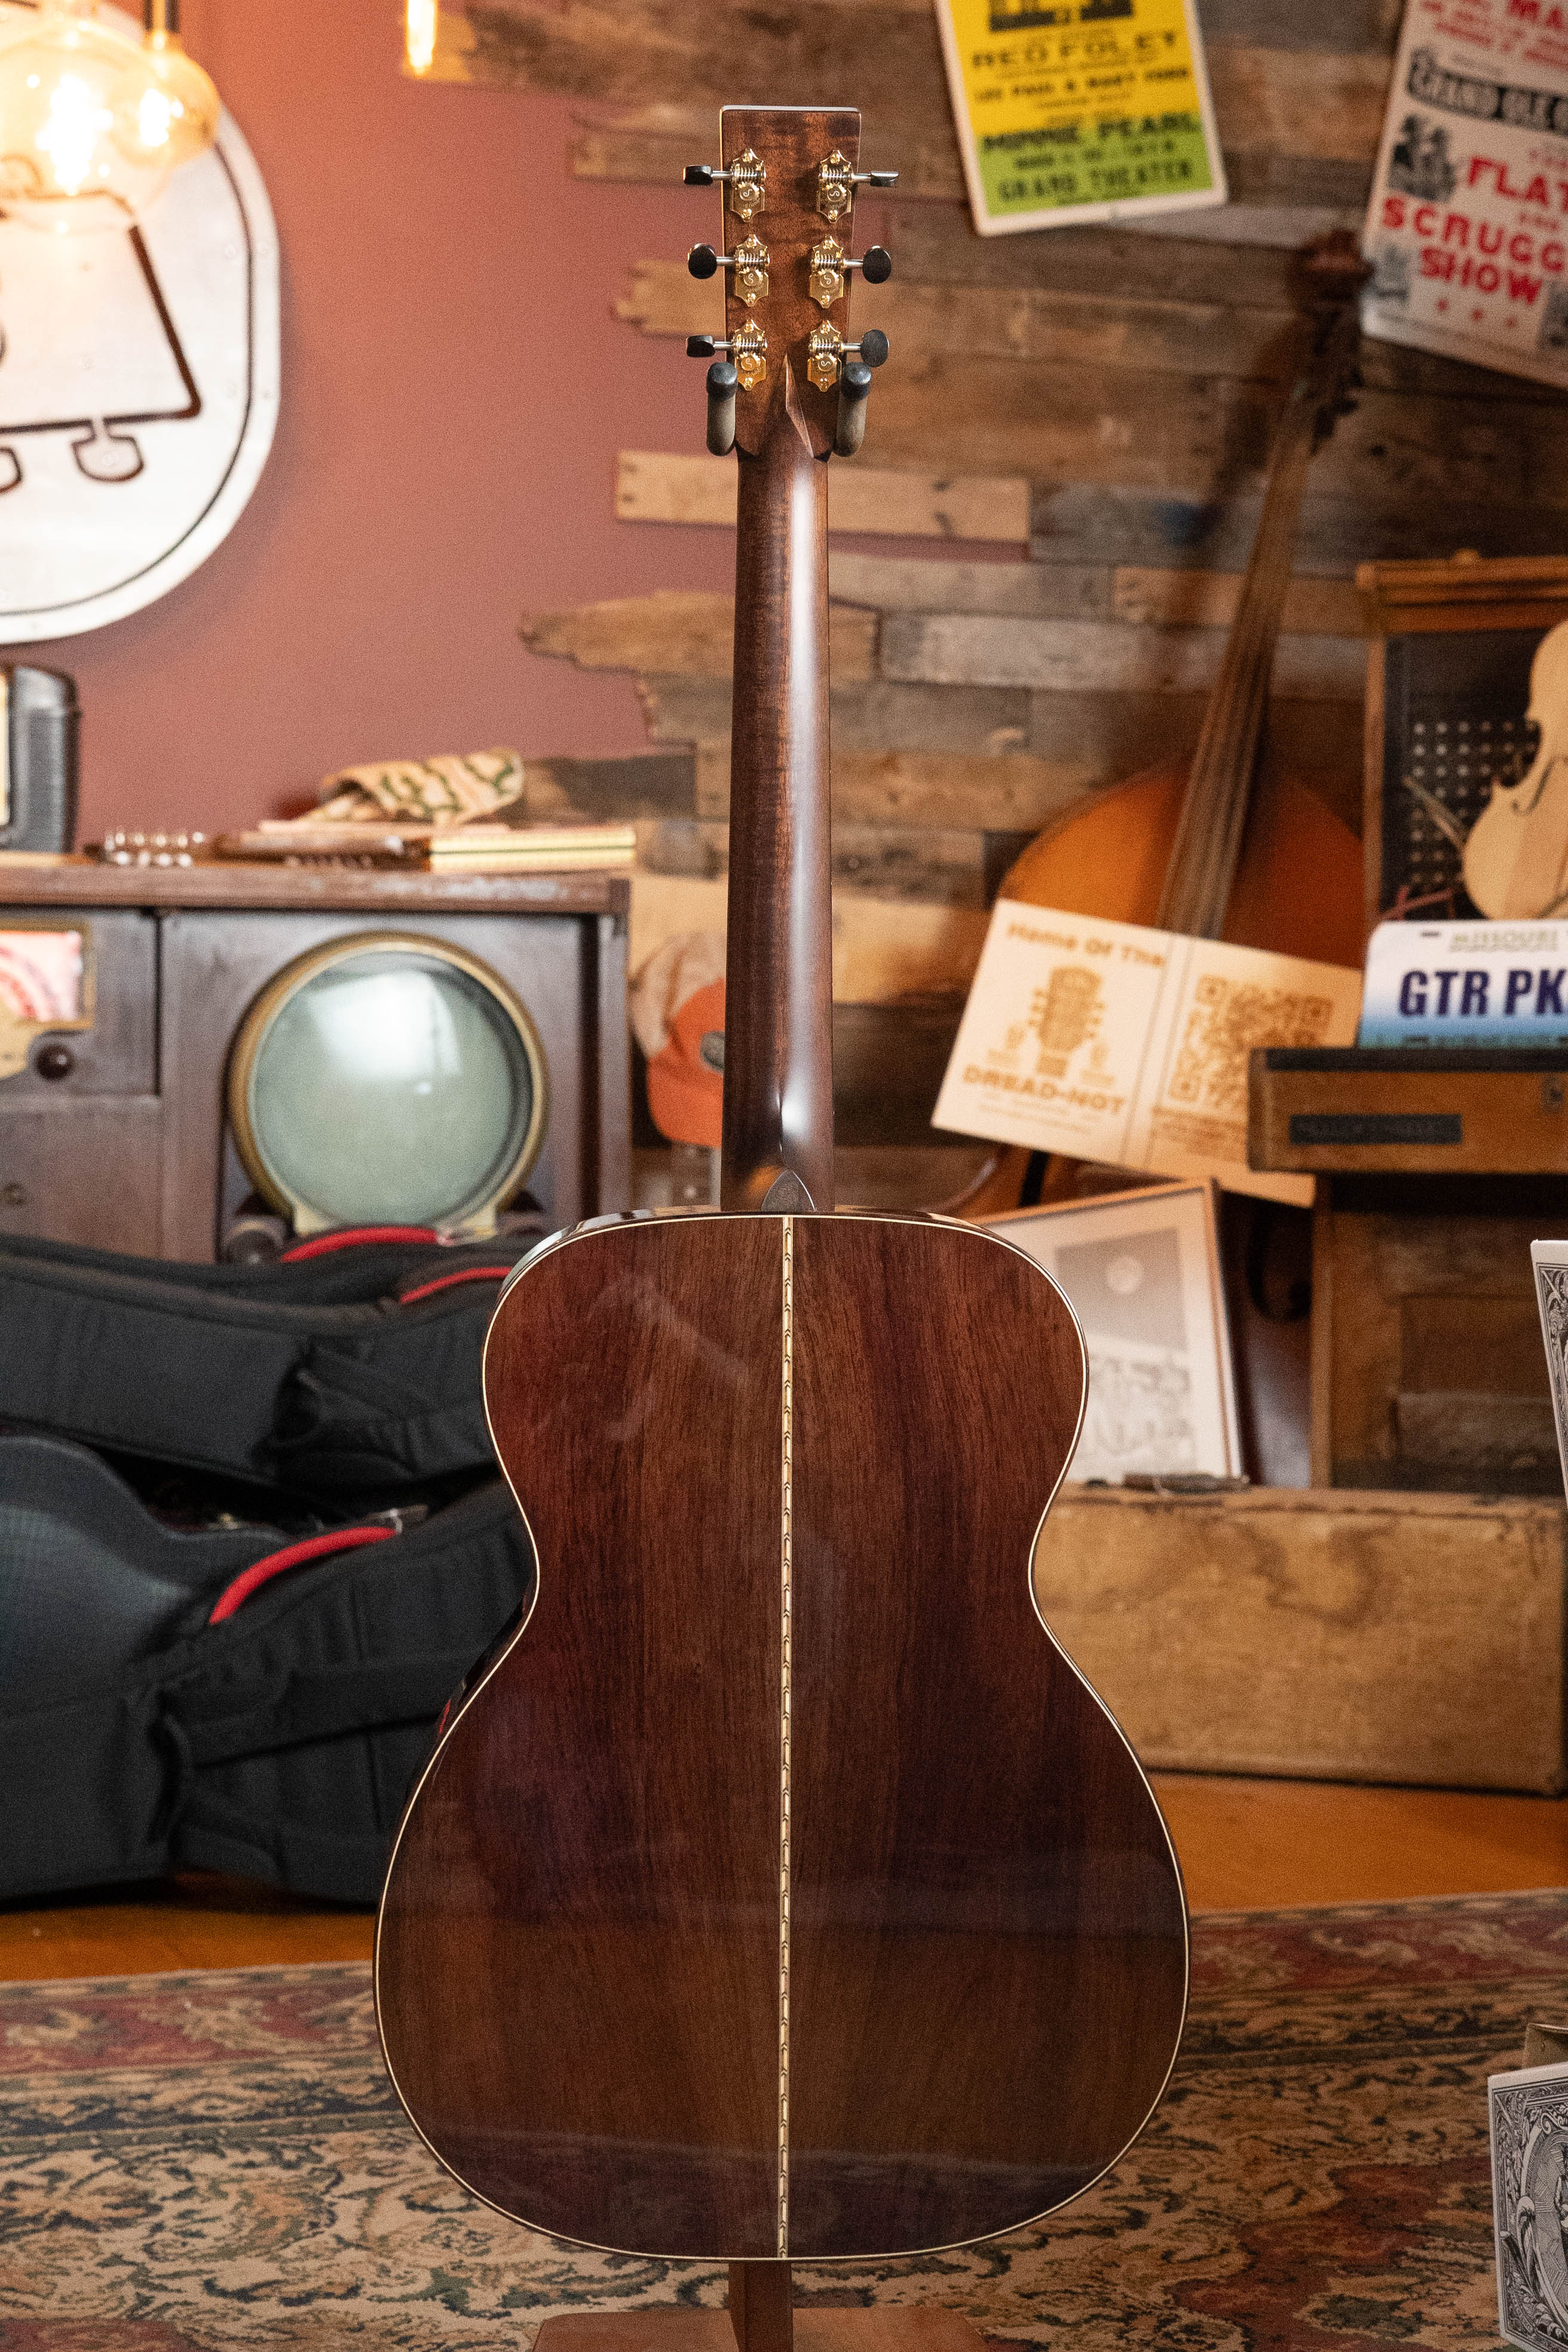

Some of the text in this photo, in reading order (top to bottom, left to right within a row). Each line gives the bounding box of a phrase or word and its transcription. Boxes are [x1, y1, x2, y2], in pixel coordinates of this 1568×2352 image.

[997, 174, 1077, 202] GRAND
[1089, 158, 1194, 186] THEATER
[1420, 246, 1542, 305] SHOW
[1006, 922, 1167, 967] Home Of The
[1398, 969, 1490, 1017] GTR
[961, 1064, 1126, 1114] DREAD-NOT
